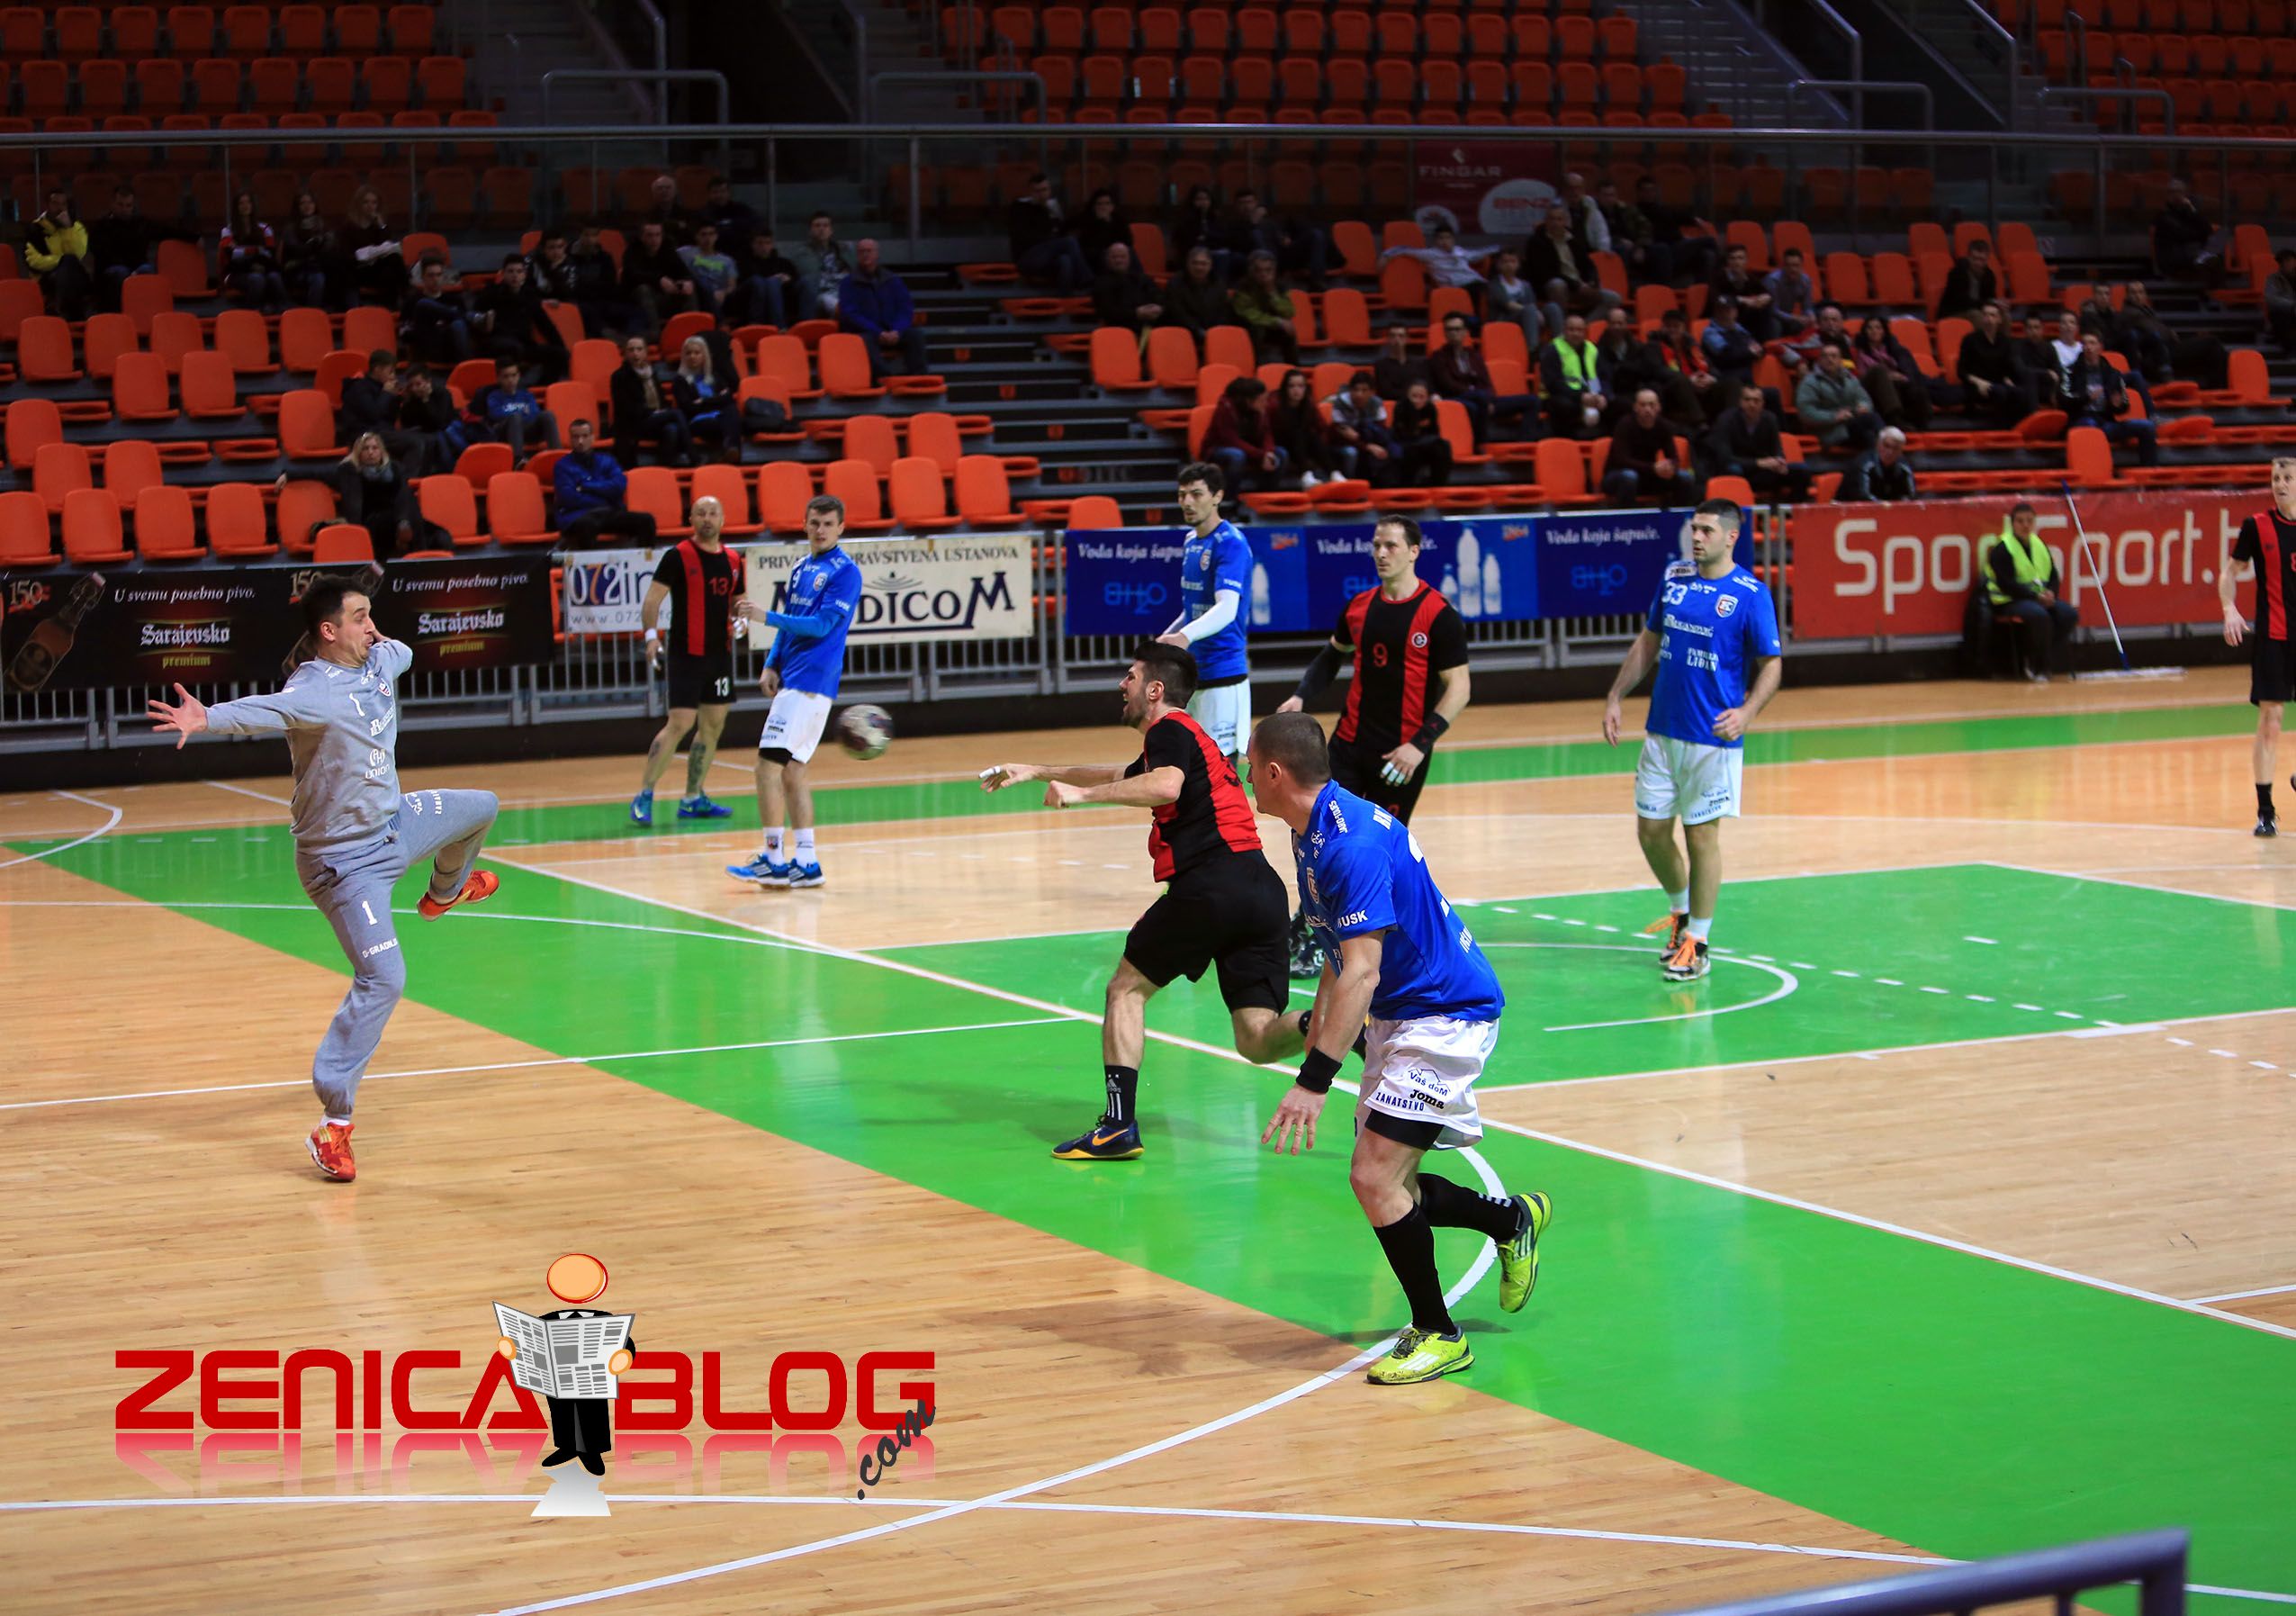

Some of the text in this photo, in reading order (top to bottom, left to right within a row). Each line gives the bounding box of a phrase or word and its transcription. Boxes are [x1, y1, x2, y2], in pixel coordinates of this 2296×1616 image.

[1545, 528, 1580, 545] Voda
[1582, 528, 1611, 546] koja
[945, 546, 1019, 563] USTANOVA
[1077, 543, 1184, 563] Voda koja šapu
[392, 579, 403, 592] U
[405, 579, 446, 592] svemu
[446, 575, 498, 592] posebno
[708, 576, 729, 596] 13
[788, 569, 797, 586] 9
[114, 587, 257, 604] U svemu posebno pivo.
[772, 571, 1015, 627] MDICOM
[1661, 581, 1688, 606] 33
[418, 608, 505, 635] Sarajevsko
[140, 621, 230, 647] Sarajevsko
[162, 653, 212, 669] premium
[1373, 642, 1388, 667] 9
[715, 676, 730, 696] 13
[362, 900, 378, 925] 1
[1409, 1071, 1427, 1086] Vaš
[1375, 1091, 1425, 1112] ZANATSTVO
